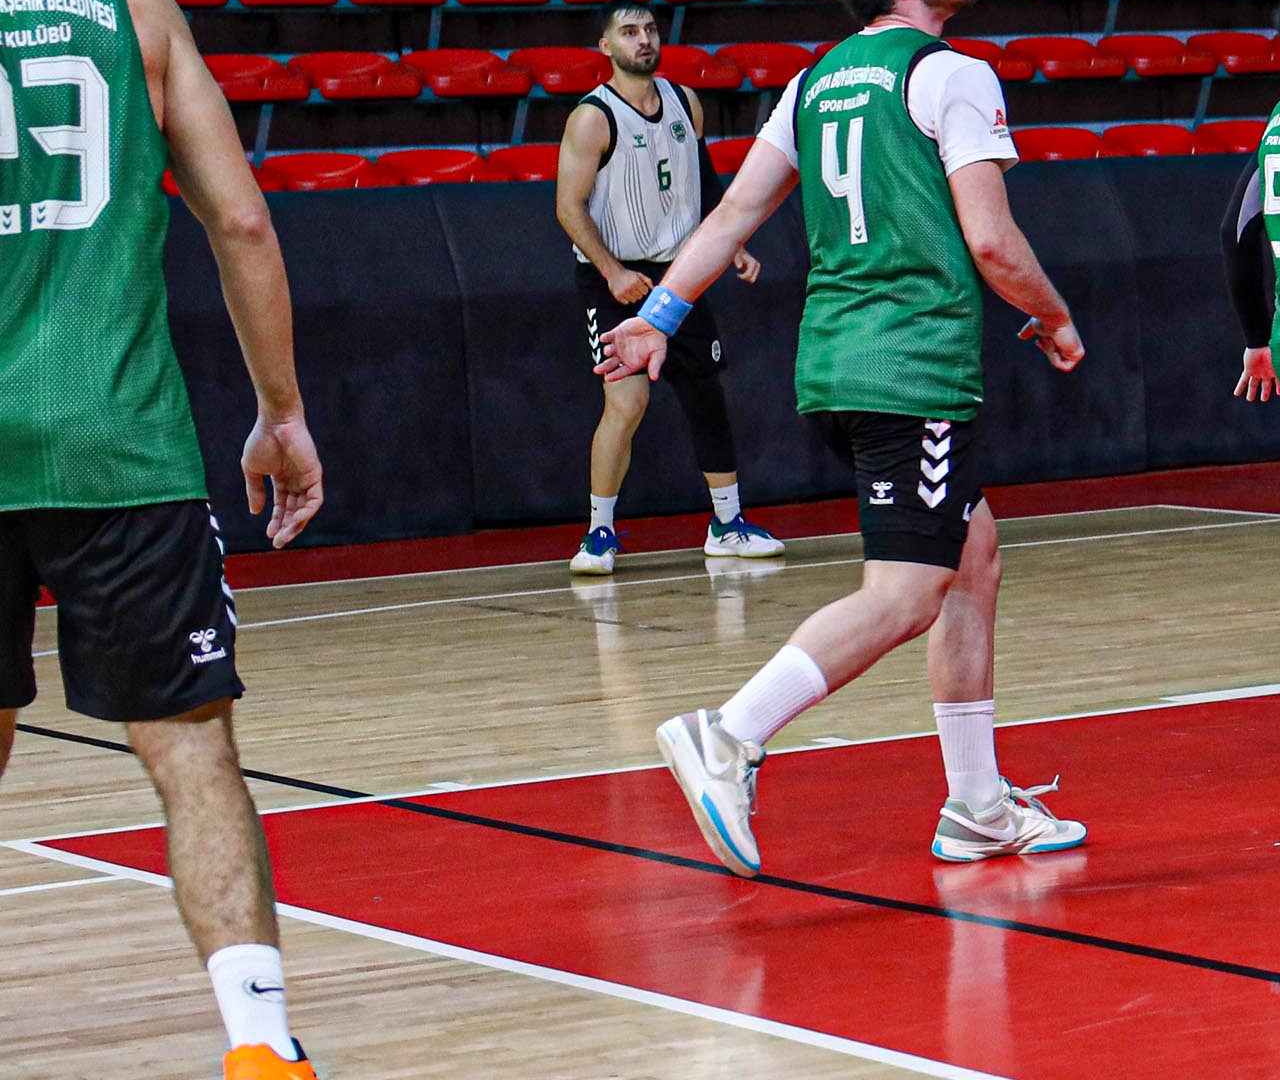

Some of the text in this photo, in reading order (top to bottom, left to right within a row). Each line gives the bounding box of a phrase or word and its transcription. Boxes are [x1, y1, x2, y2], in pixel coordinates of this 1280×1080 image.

[4, 22, 72, 48] KULÜBÜ
[818, 99, 843, 113] SPOR
[0, 55, 111, 235] 3
[657, 158, 672, 192] 6
[821, 117, 868, 245] 4
[190, 646, 226, 664] hummel
